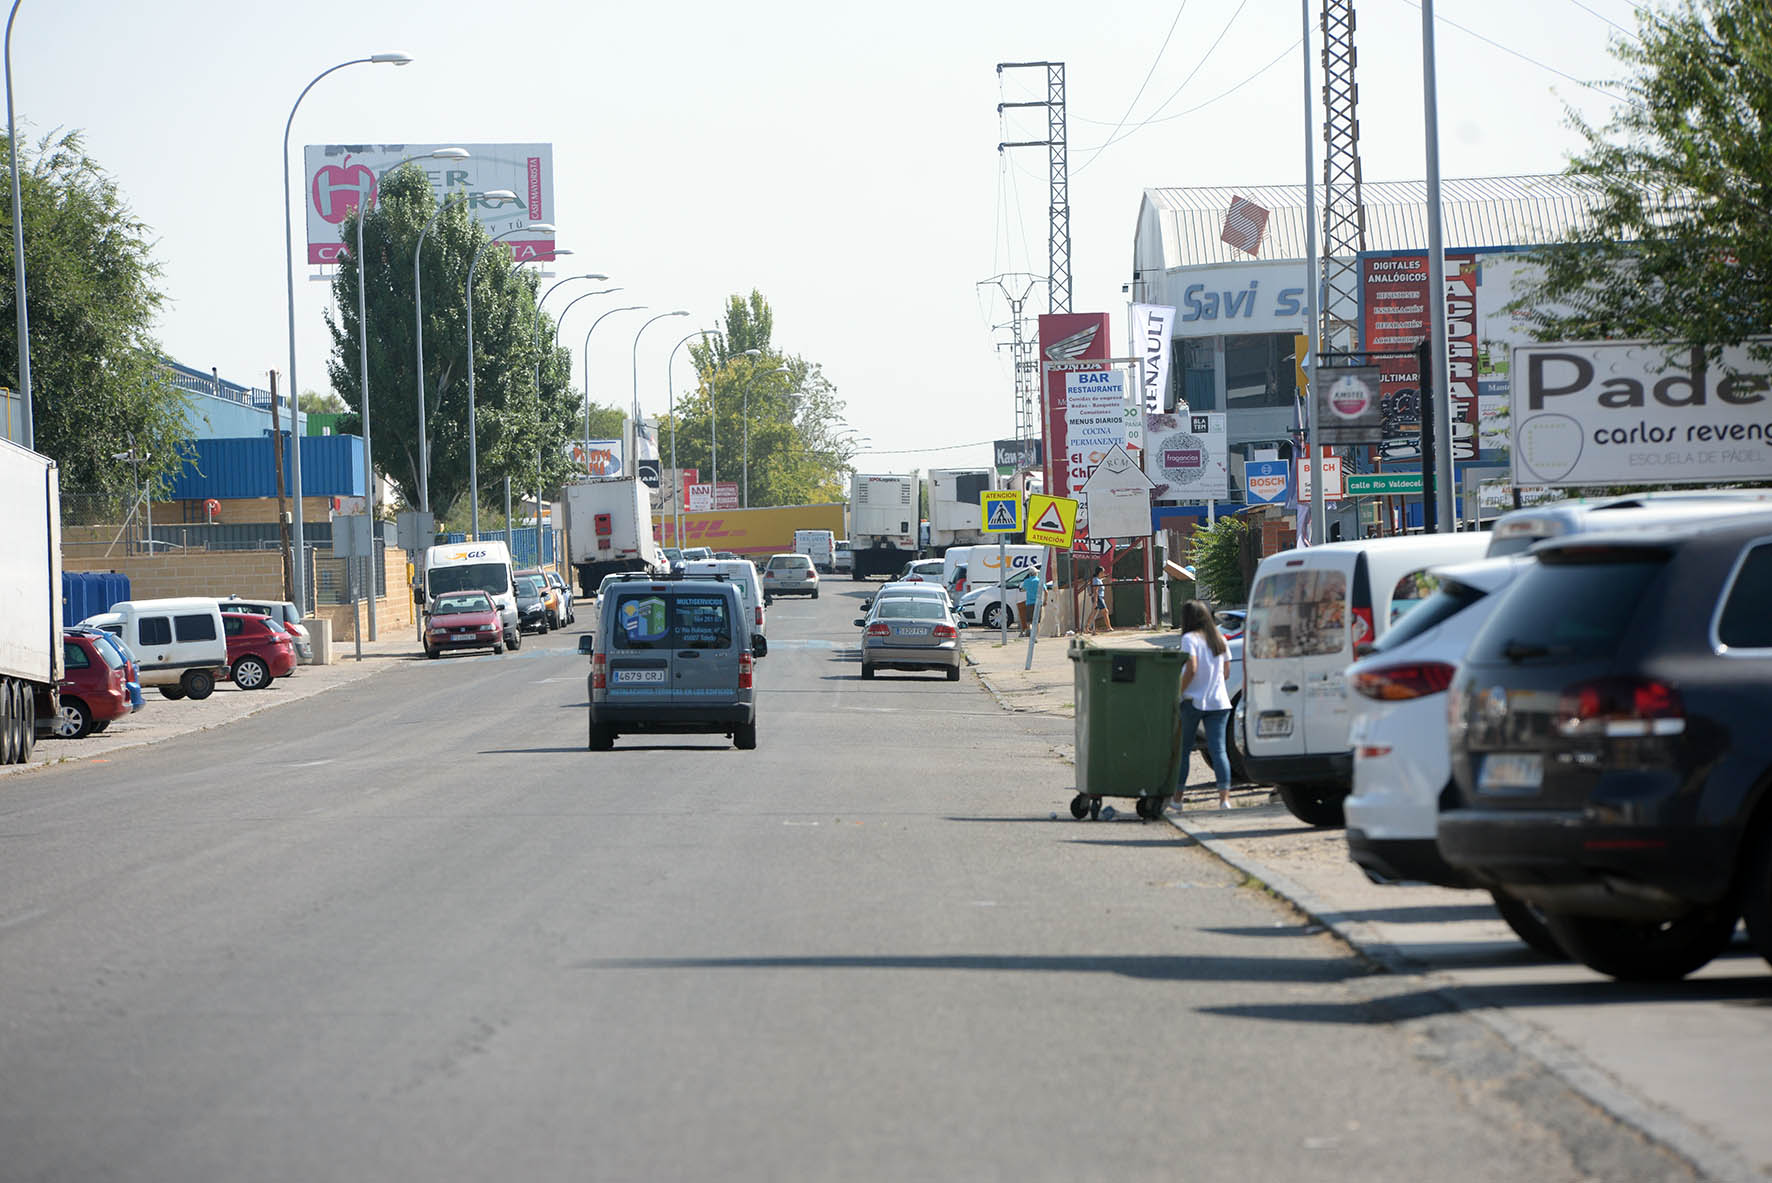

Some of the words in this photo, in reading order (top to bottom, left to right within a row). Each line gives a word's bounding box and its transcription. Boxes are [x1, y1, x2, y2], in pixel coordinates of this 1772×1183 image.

[1373, 261, 1420, 270] DIGITALES
[1368, 272, 1427, 283] ANALÓGICOS
[1182, 280, 1258, 321] Savi
[1146, 311, 1164, 415] RENAULT
[1079, 373, 1110, 384] BAR
[1380, 373, 1421, 382] ULTIMAR
[1068, 385, 1123, 394] RESTAURANTE
[1082, 427, 1112, 435] COCINA
[1594, 421, 1676, 445] carlos
[1070, 437, 1124, 447] PERMANENTE
[1629, 453, 1694, 466] ESCUELA
[1698, 451, 1720, 464] DE
[1304, 464, 1336, 472] BCH
[1250, 478, 1285, 487] BOSCH
[1389, 479, 1423, 488] Valdecel
[1032, 534, 1065, 544] ATENCIÓN
[1012, 555, 1038, 568] GLS
